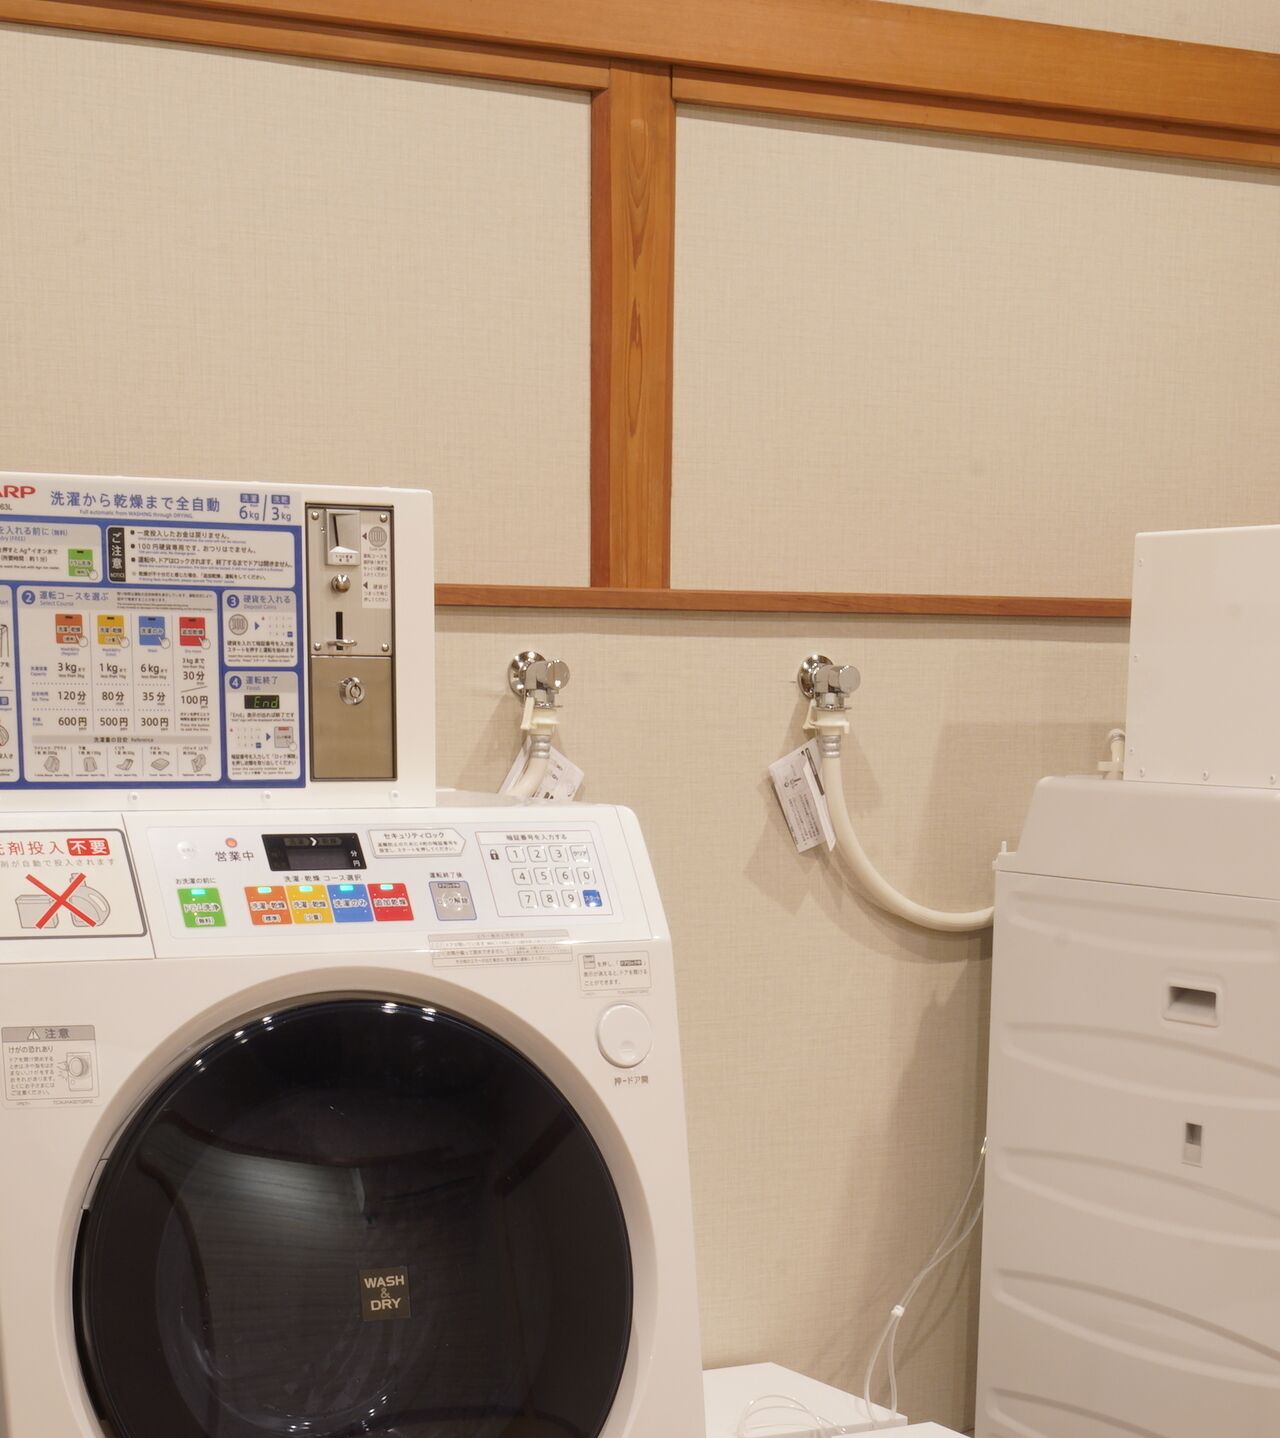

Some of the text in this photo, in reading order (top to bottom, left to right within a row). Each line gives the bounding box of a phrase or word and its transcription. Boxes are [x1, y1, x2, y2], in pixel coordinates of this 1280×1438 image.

[50, 490, 220, 512] 洗濯から乾燥まで全自動
[254, 696, 278, 708] End
[70, 840, 108, 854] 不要
[214, 851, 255, 862] 営業中
[534, 850, 540, 858] 2
[556, 850, 562, 858] 3
[519, 872, 590, 881] 4 5 6 0
[525, 894, 574, 903] 7 8 9
[364, 1275, 404, 1288] WASH
[381, 1288, 391, 1298] &
[371, 1298, 401, 1311] DRY
